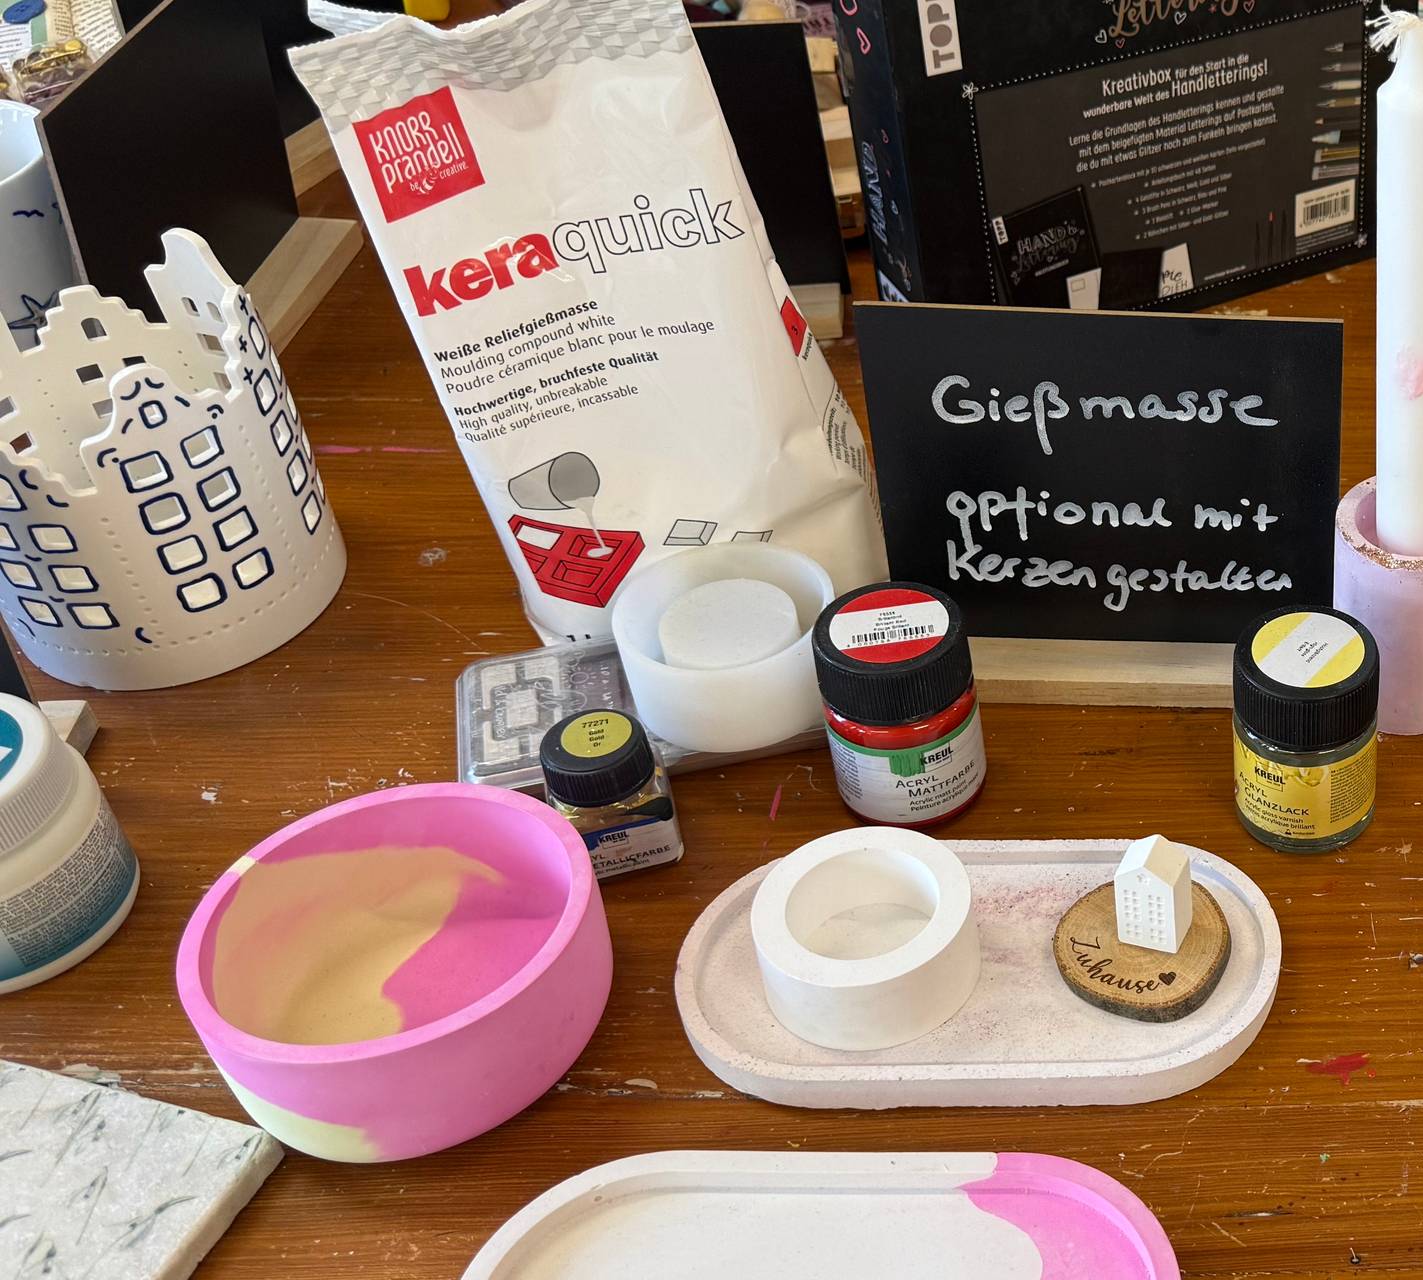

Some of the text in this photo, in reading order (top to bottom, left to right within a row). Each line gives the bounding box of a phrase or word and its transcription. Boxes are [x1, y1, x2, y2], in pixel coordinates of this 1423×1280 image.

[926, 0, 955, 69] TOP
[1083, 58, 1268, 118] wunderbare Welt des Handletterings!
[1102, 53, 1249, 97] Kreativbox für den Start in die
[368, 111, 439, 164] KNORR
[1069, 85, 1284, 146] Lerne die Grundlagen des Handletterings kennen und gestalte
[1079, 102, 1275, 158] mit dem beigefügten Material Letterings auf Postkarten,
[381, 122, 465, 194] prandell
[1076, 114, 1278, 173] die du mit etwas Glitzer noch zum Funkeln bringen kannst.
[403, 188, 745, 317] keraquick
[434, 299, 599, 363] Weiße Reliefgießmasse
[441, 314, 616, 379] Moulding compound white
[446, 318, 716, 394] Poudre céramique blanc pour le moulage
[454, 350, 660, 417] Hochwertige, bruchfeste Qualität
[459, 375, 609, 431] High quality, unbreakable
[464, 383, 640, 444] Qualité supérieure, incassable
[931, 374, 1279, 455] Gießmasse
[946, 486, 1279, 551] optional mit
[947, 540, 1097, 588] Kerzen
[581, 718, 610, 728] 77271
[588, 728, 604, 736] Gold
[589, 735, 605, 743] Gold
[896, 775, 939, 789] ACRYL
[907, 760, 976, 798] MATTFARBE
[920, 745, 953, 766] KREUL
[1254, 767, 1285, 785] KREUL
[909, 795, 933, 807] Acrylic
[934, 790, 949, 801] matt
[910, 799, 941, 813] Peinture
[1238, 771, 1267, 798] ACRYL
[1244, 786, 1310, 816] GLANZLACK
[598, 830, 630, 844] KREUL
[1278, 814, 1304, 824] varnish
[1069, 936, 1160, 994] Zuhause
